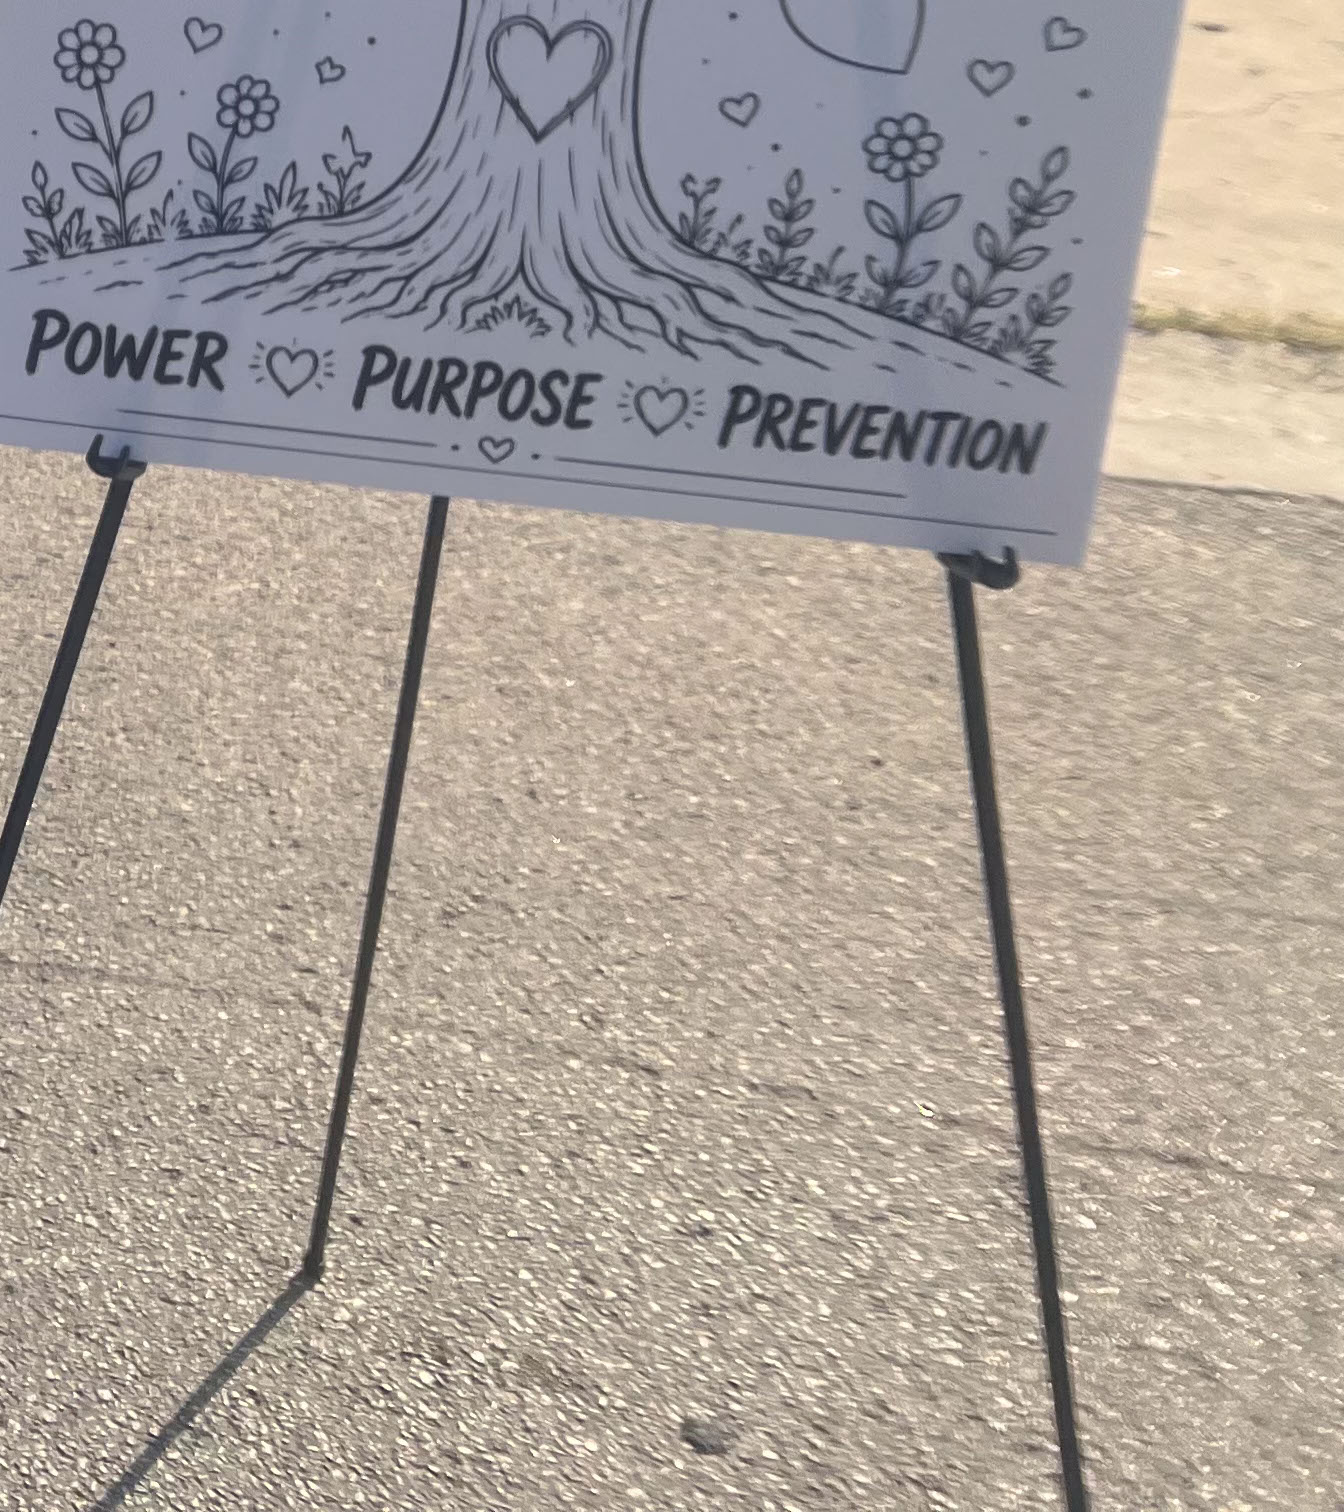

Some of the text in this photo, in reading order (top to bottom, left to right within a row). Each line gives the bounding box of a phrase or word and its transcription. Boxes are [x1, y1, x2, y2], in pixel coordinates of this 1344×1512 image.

[23, 307, 1051, 477] POWER PURPOSE PREVENTION
